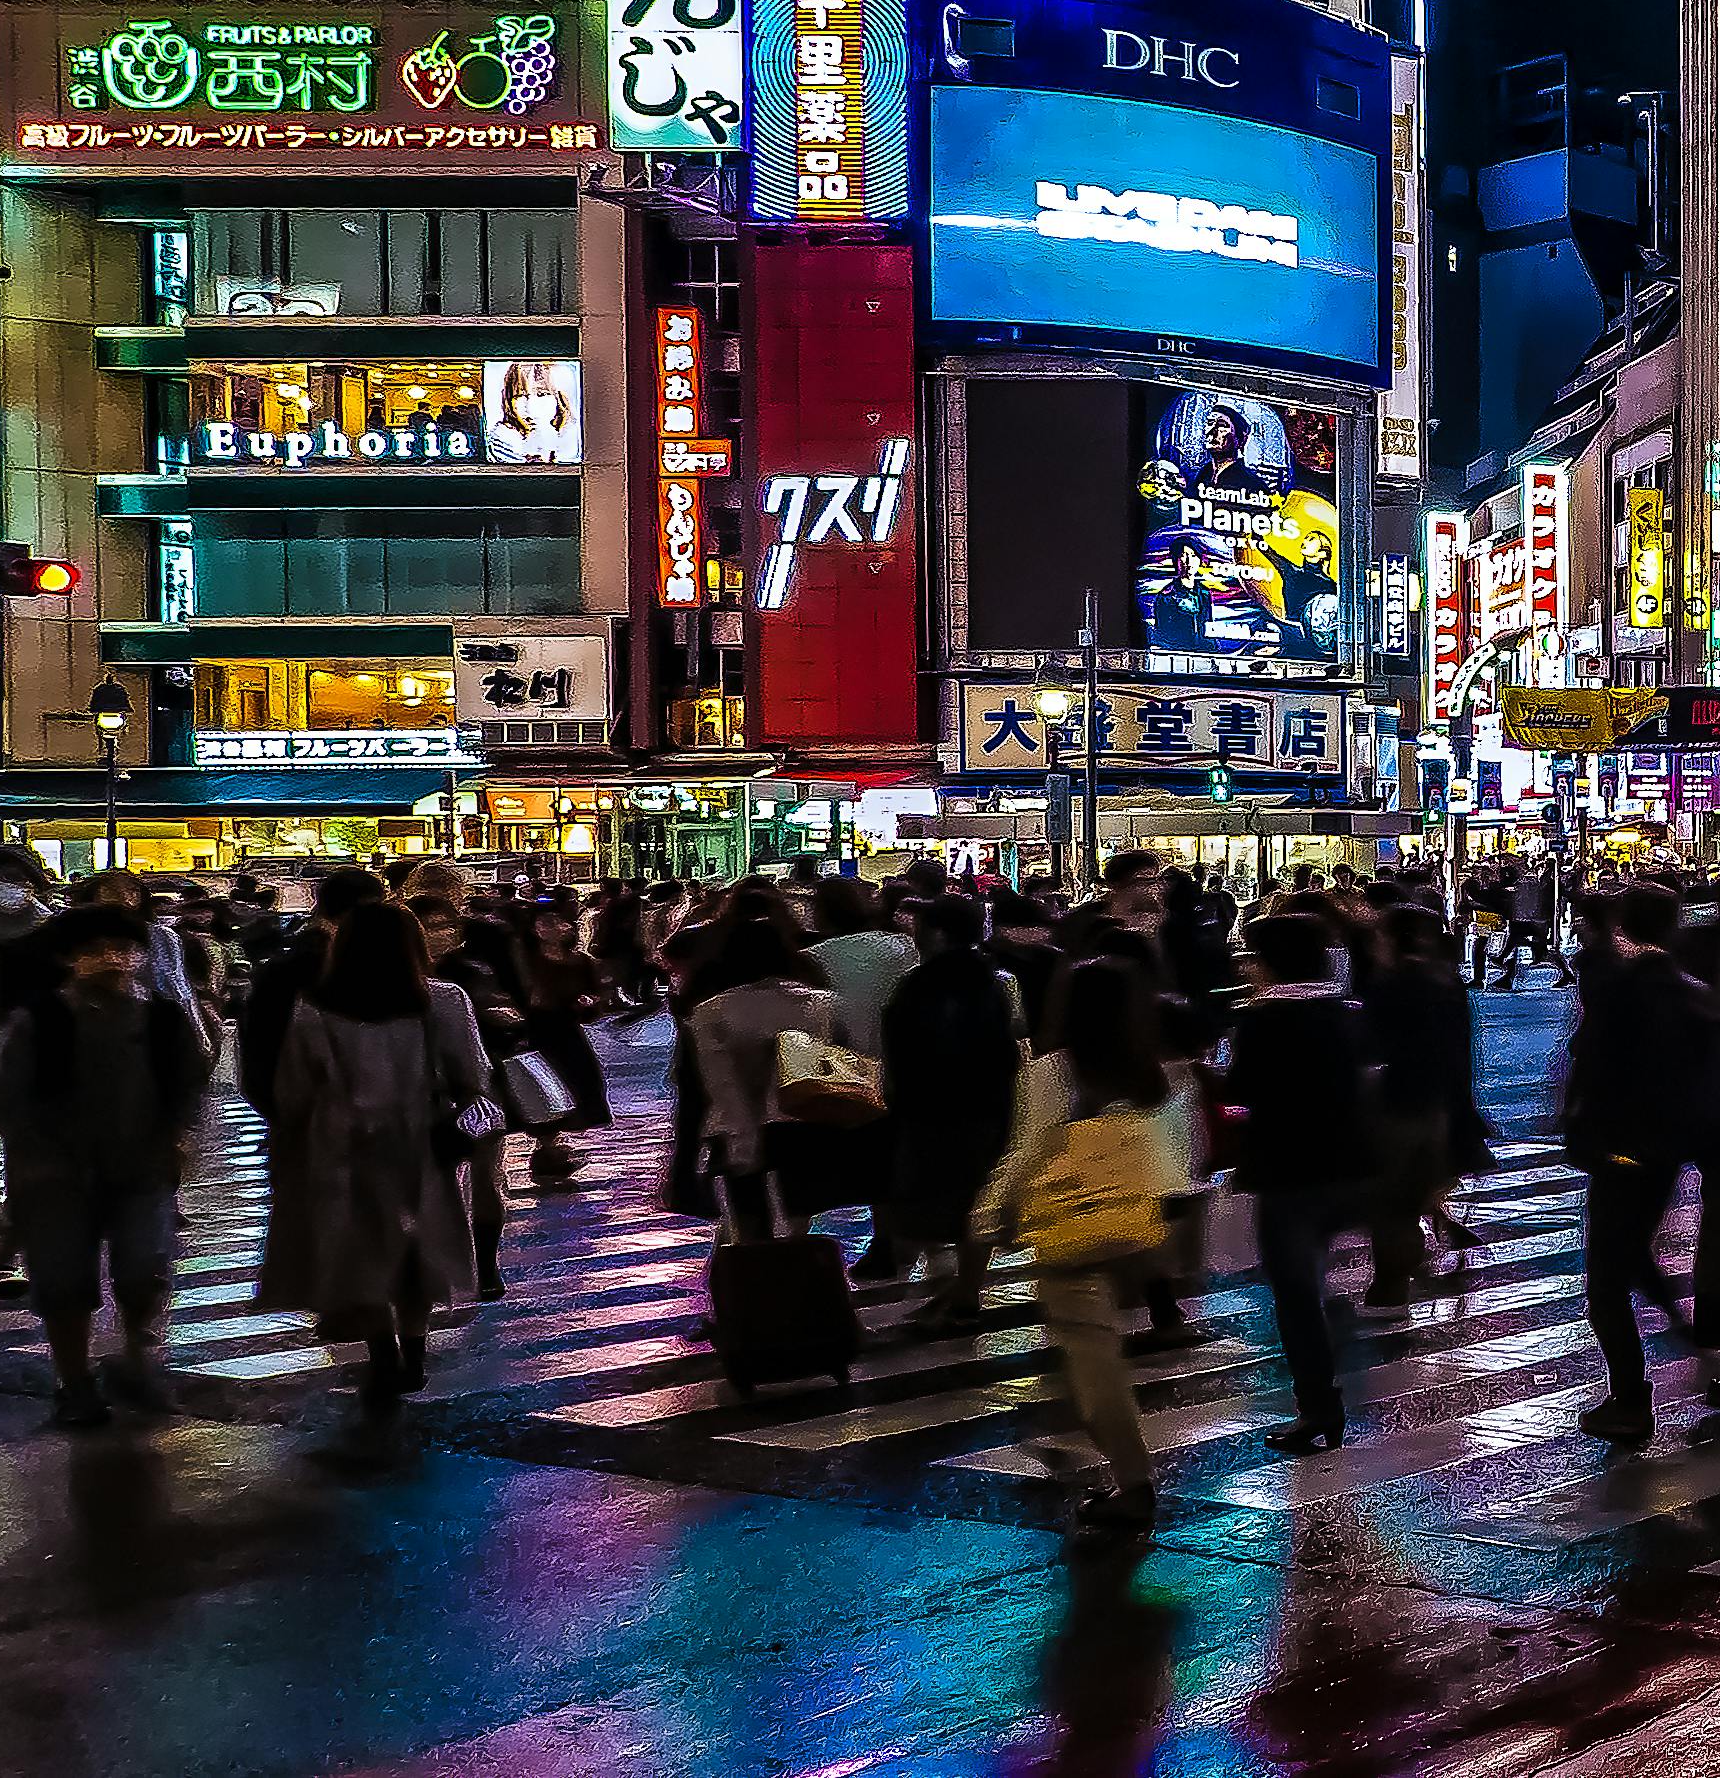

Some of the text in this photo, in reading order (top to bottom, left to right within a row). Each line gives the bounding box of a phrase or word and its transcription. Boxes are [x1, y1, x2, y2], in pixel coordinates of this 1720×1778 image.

[206, 50, 371, 112] 西村
[1100, 28, 1241, 89] DHC
[204, 422, 472, 468] Euphoria
[1197, 483, 1269, 508] teamLab
[1181, 498, 1301, 540] Planets
